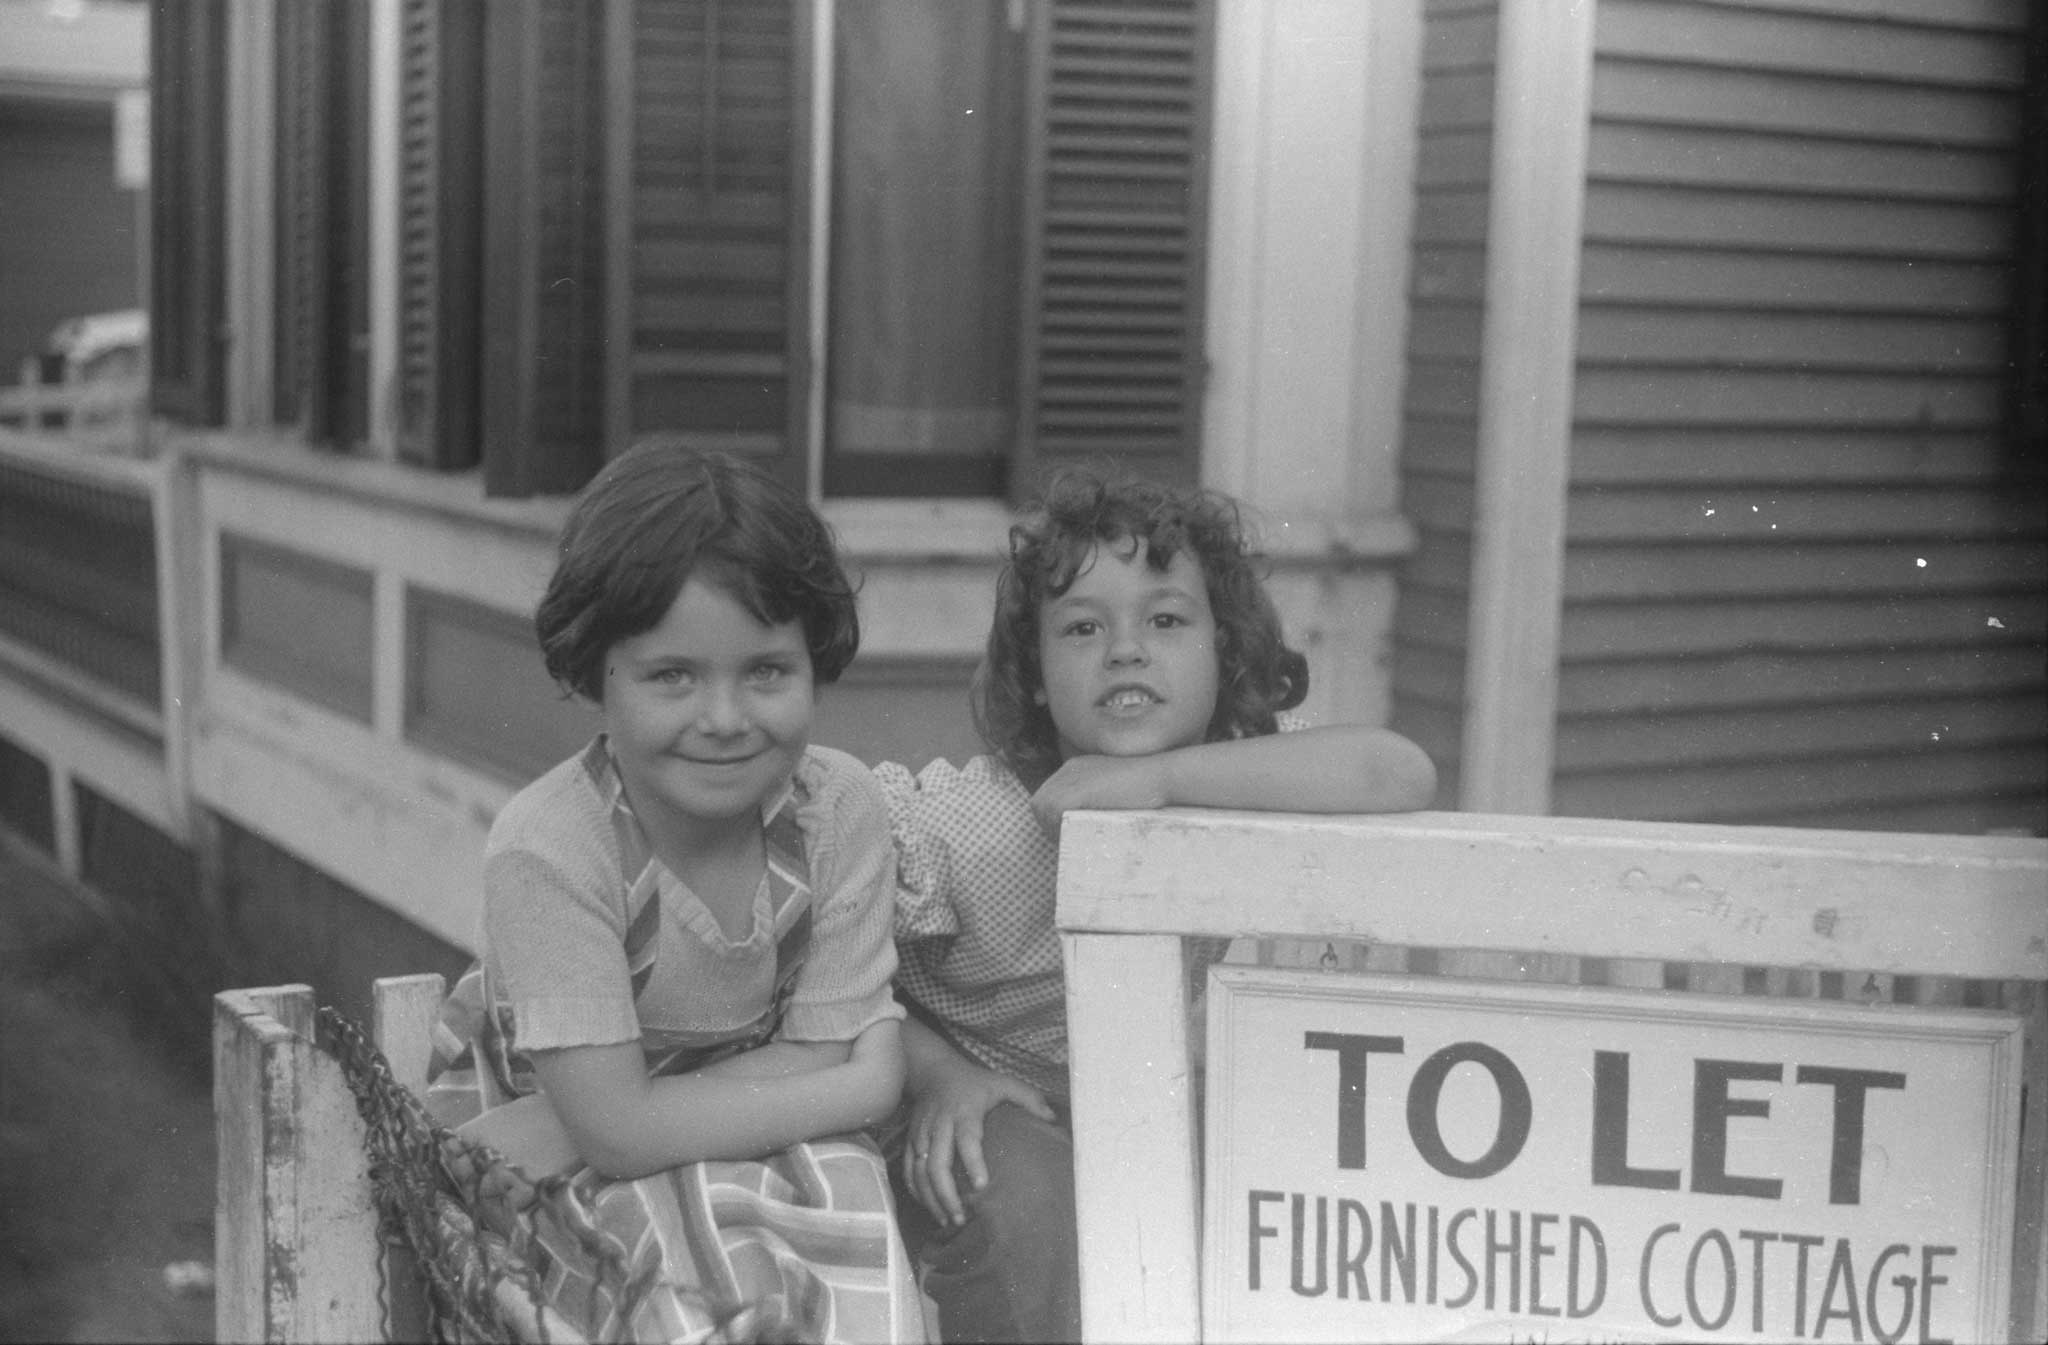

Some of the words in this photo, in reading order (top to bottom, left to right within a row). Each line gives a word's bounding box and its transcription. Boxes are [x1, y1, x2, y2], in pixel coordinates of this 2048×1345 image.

[1304, 1031, 1532, 1179] TO
[1592, 1050, 1907, 1205] LET
[1248, 1190, 1607, 1319] FURNISHED
[1639, 1223, 1957, 1345] COTTAGE
